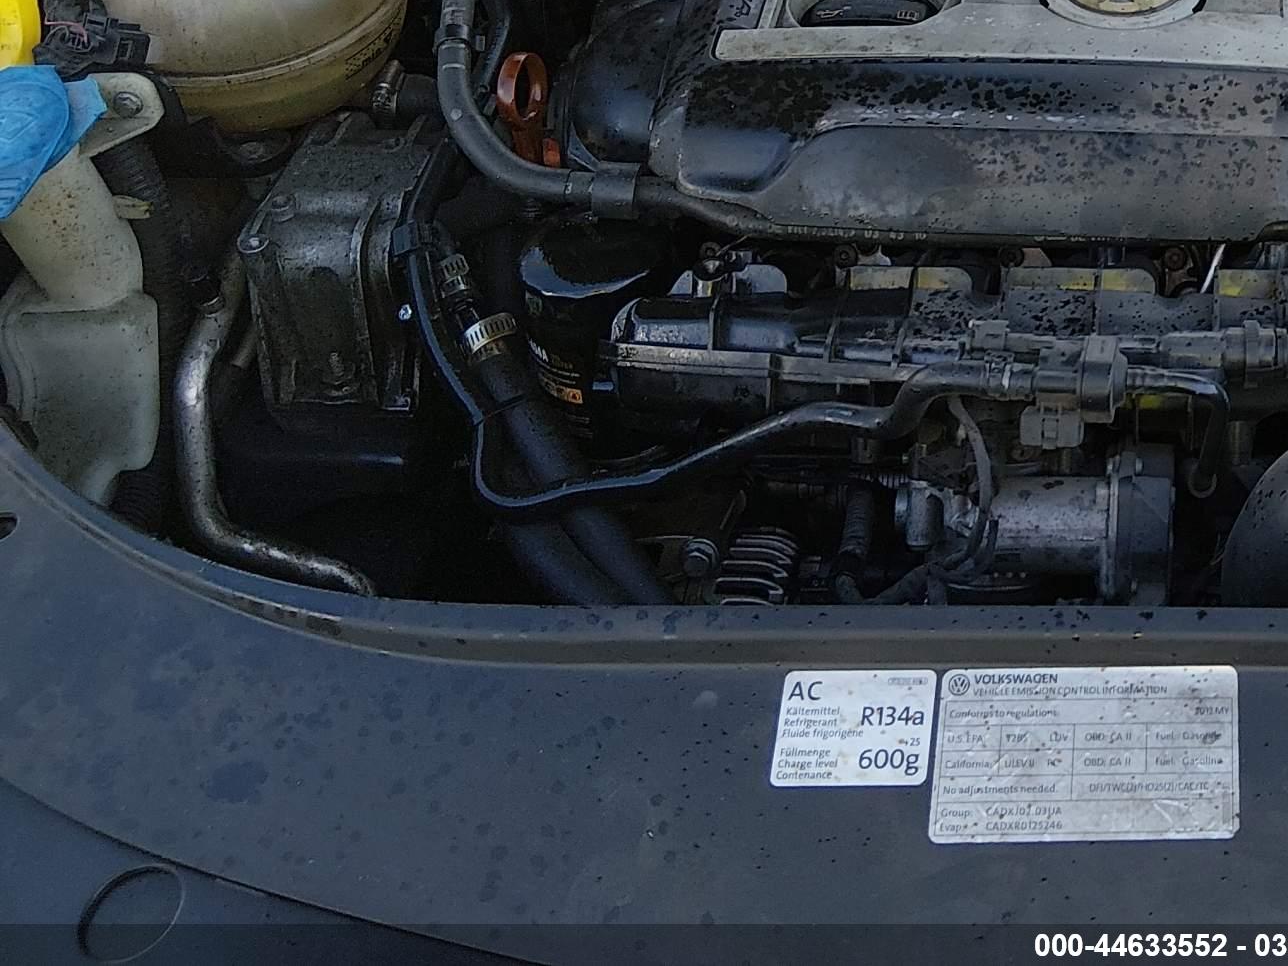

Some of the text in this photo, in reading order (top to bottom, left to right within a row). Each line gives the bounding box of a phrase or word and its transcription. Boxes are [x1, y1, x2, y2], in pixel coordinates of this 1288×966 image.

[974, 674, 1058, 684] VOLKSWAGEN
[788, 681, 823, 700] AC
[1057, 685, 1102, 695] CONTROL
[785, 706, 840, 716] Kältemittel
[860, 706, 924, 726] R134a
[784, 717, 838, 728] Refrigerant
[781, 728, 864, 740] Fluide frigorigène
[780, 748, 831, 758] Füllmenge
[777, 758, 838, 770] Charge level
[858, 748, 919, 776] 600g
[776, 770, 832, 780] Contenance
[943, 786, 956, 794] No
